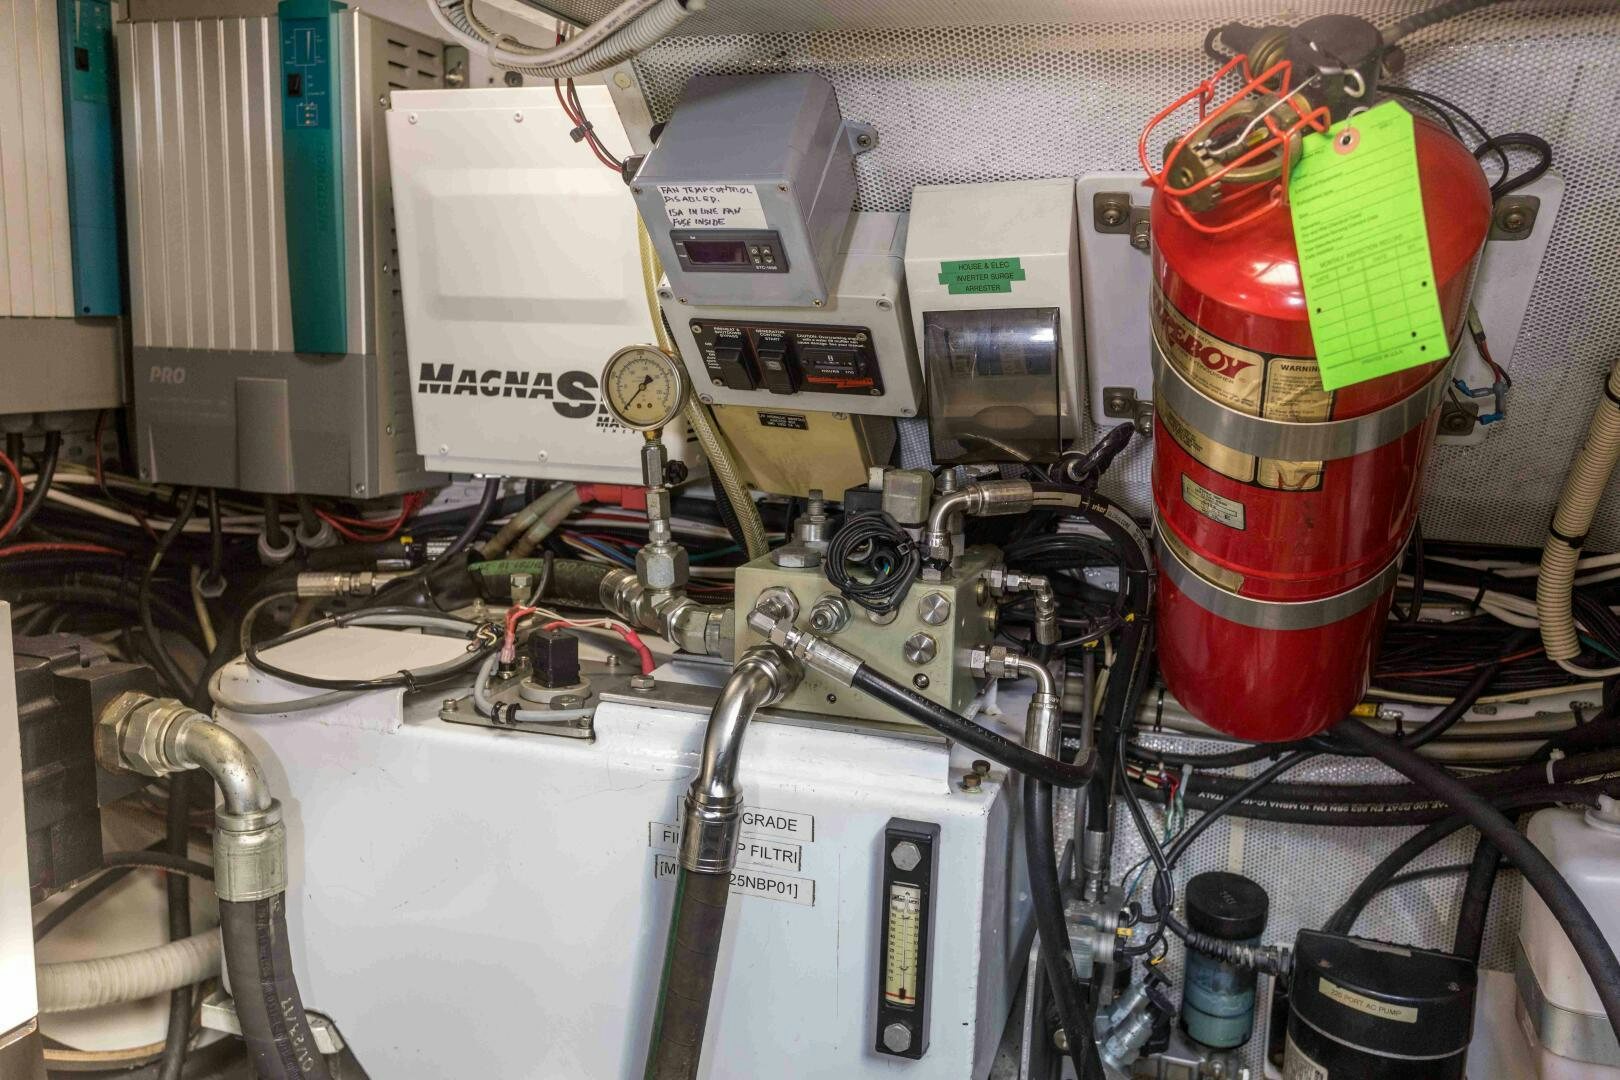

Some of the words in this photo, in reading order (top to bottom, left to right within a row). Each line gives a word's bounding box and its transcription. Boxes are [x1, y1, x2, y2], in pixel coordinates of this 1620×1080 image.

[660, 186, 680, 194] FAN
[722, 207, 742, 215] FAN
[673, 218, 692, 227] FUSE
[695, 218, 726, 226] INSIDE
[958, 263, 982, 271] HOUSE
[956, 274, 989, 282] INVERTER
[990, 272, 1014, 280] SURGE
[965, 284, 1001, 292] ARRESTER
[1280, 364, 1319, 373] WARNIN
[149, 366, 186, 384] PRO
[418, 363, 608, 418] MAGNAS
[596, 416, 626, 429] MA
[663, 830, 680, 844] FI
[750, 844, 798, 864] FILTRI
[660, 860, 680, 876] [M
[1366, 1003, 1377, 1011] AC
[1378, 1007, 1402, 1017] PUMP
